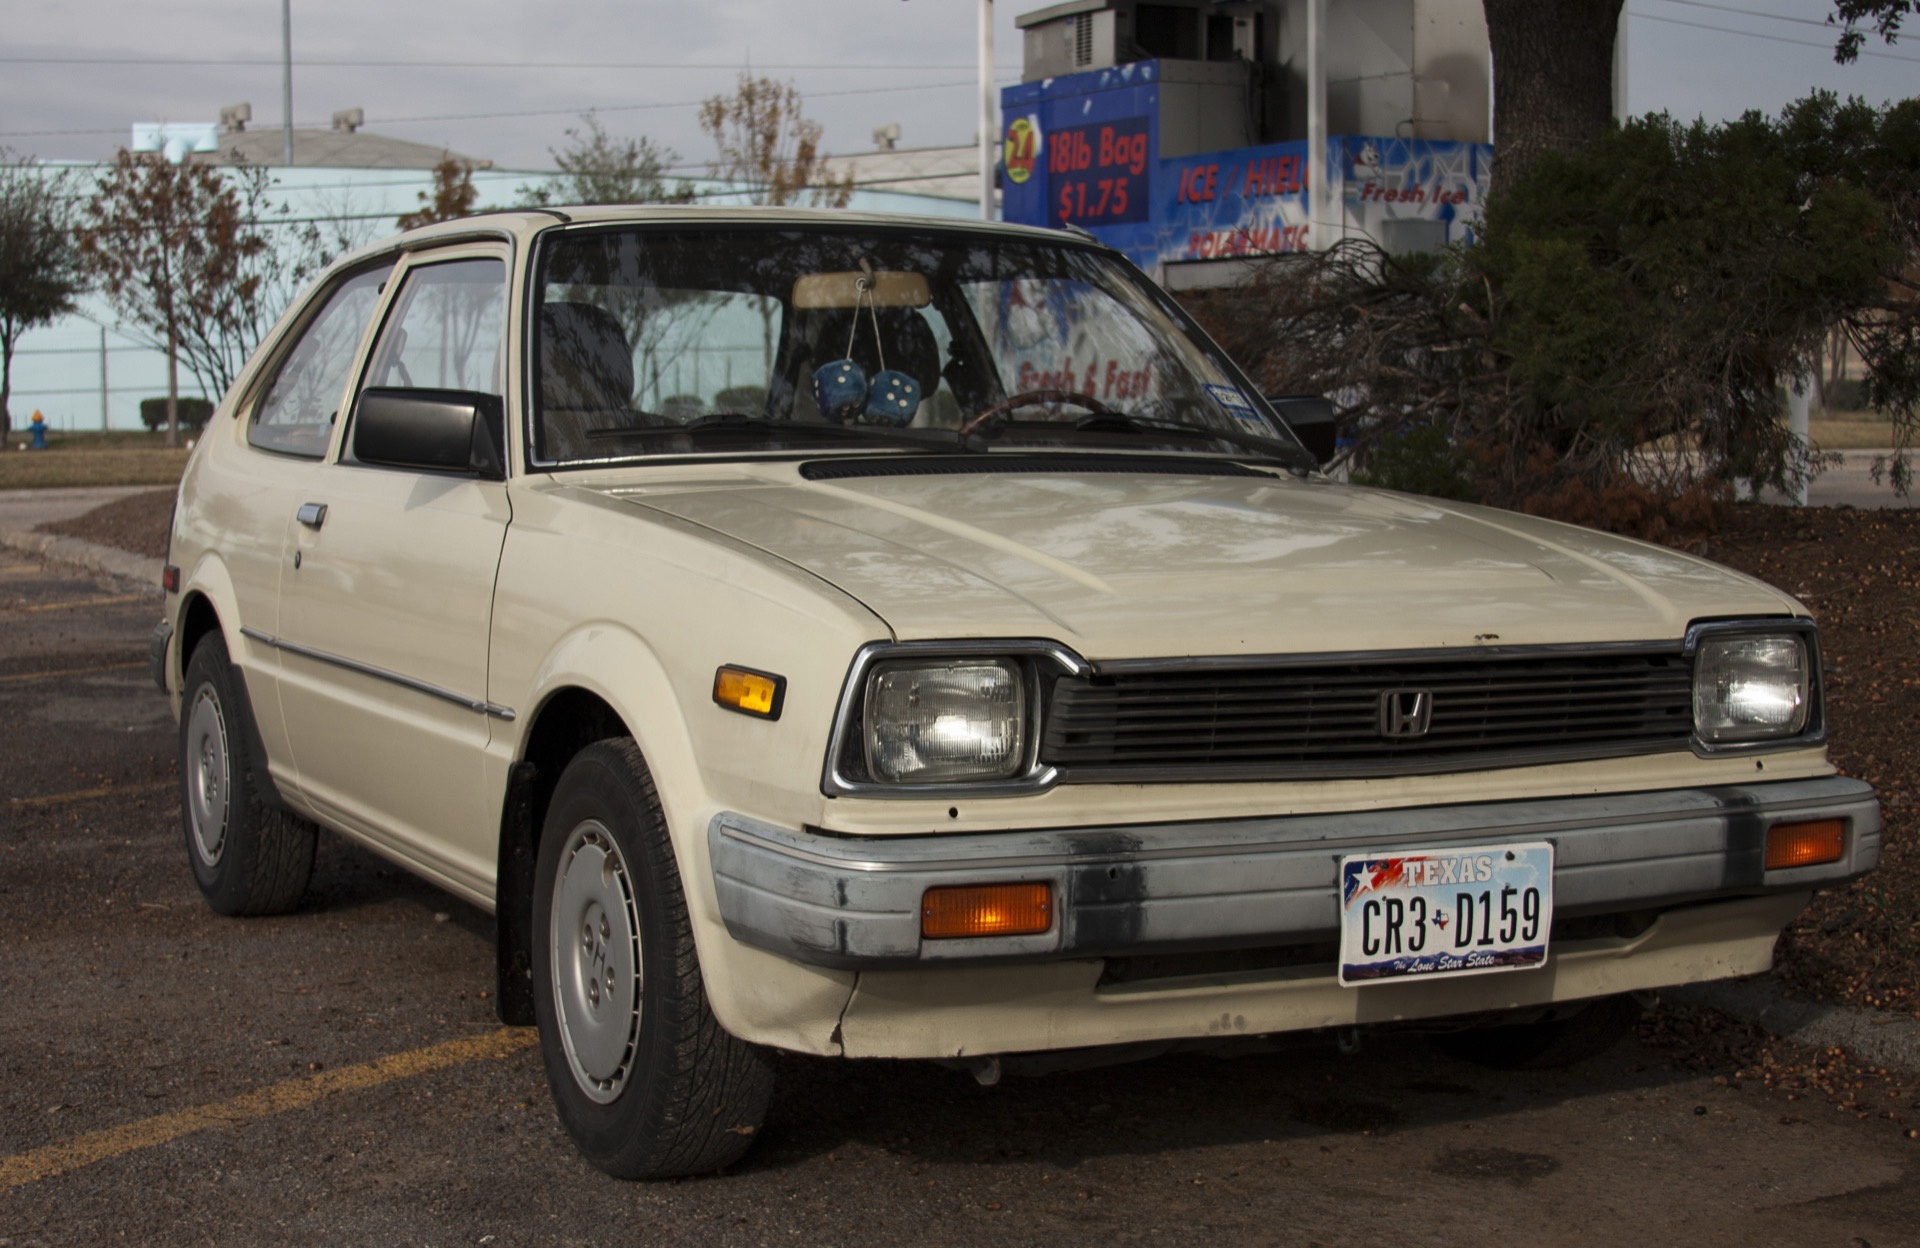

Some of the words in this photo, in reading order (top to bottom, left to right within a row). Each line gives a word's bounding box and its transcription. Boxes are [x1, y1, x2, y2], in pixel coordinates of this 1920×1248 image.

[1007, 129, 1035, 173] 24
[1098, 126, 1147, 175] Bag
[1058, 178, 1128, 224] $1.75
[1177, 164, 1219, 205] ICE
[1361, 182, 1425, 204] Fresh
[1431, 185, 1466, 205] Ice
[1402, 856, 1493, 888] TEXAS
[1362, 896, 1426, 957] CR3
[1454, 887, 1540, 949] D159
[1393, 960, 1406, 970] The
[1407, 958, 1435, 973] Lone
[1438, 955, 1463, 970] Star
[1466, 952, 1495, 967] State
